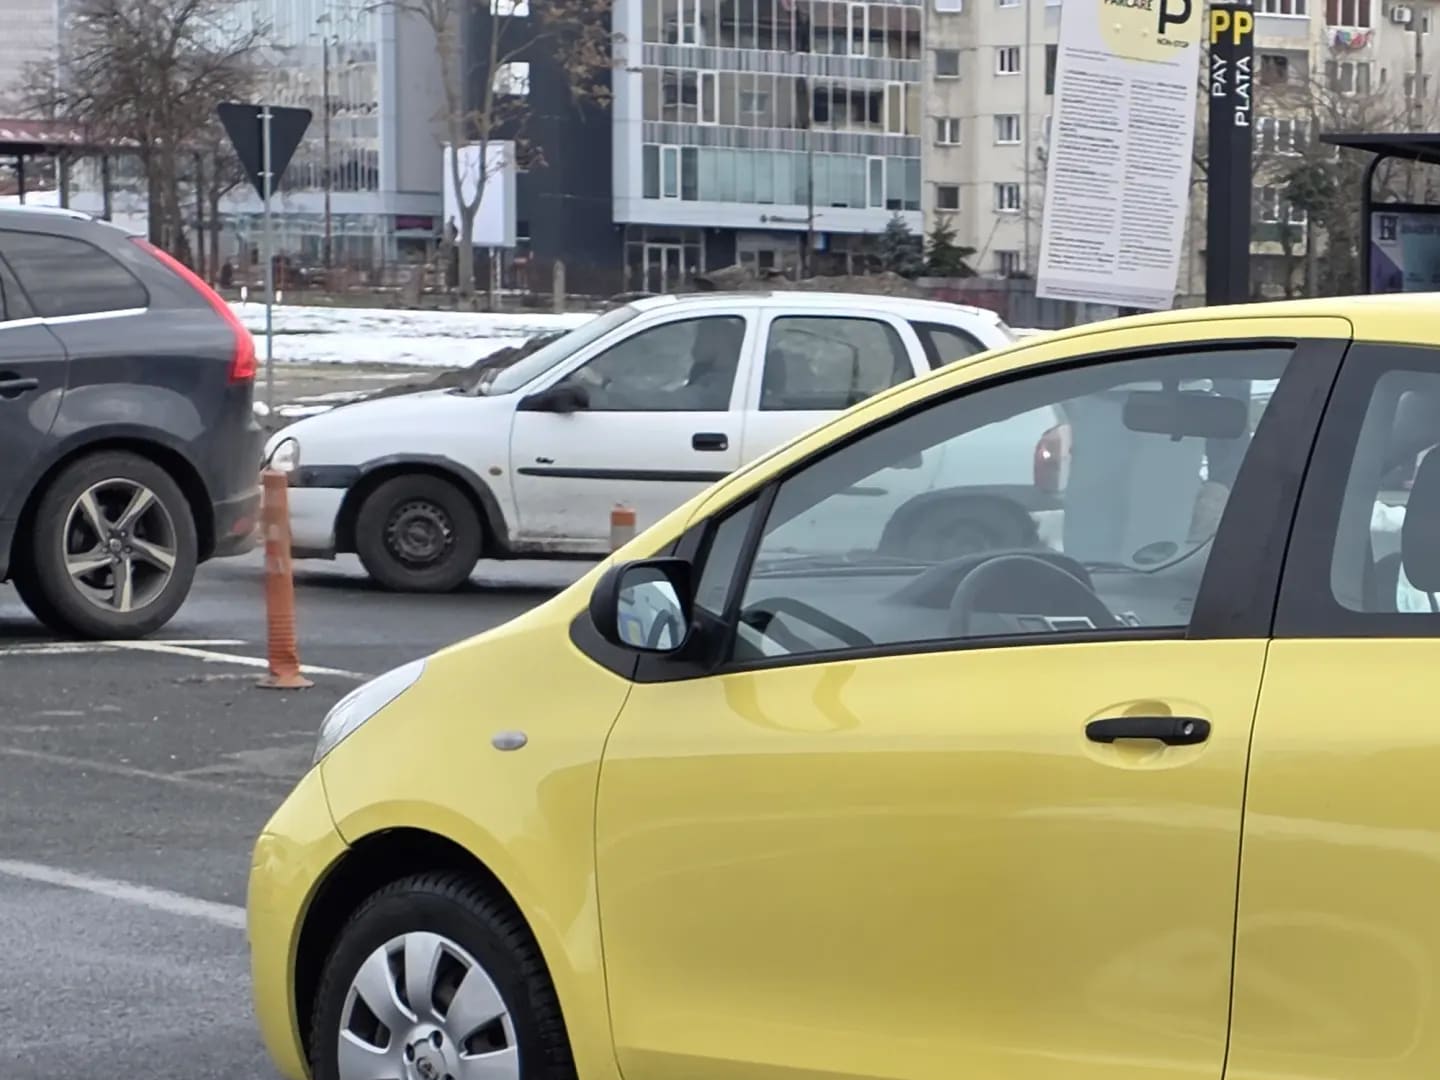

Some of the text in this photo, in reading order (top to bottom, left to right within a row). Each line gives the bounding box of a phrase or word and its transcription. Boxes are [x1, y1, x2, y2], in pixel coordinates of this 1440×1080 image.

[1158, 0, 1192, 34] P
[1211, 9, 1253, 45] PP
[1212, 53, 1228, 97] PAY
[1234, 55, 1251, 126] PLATA
